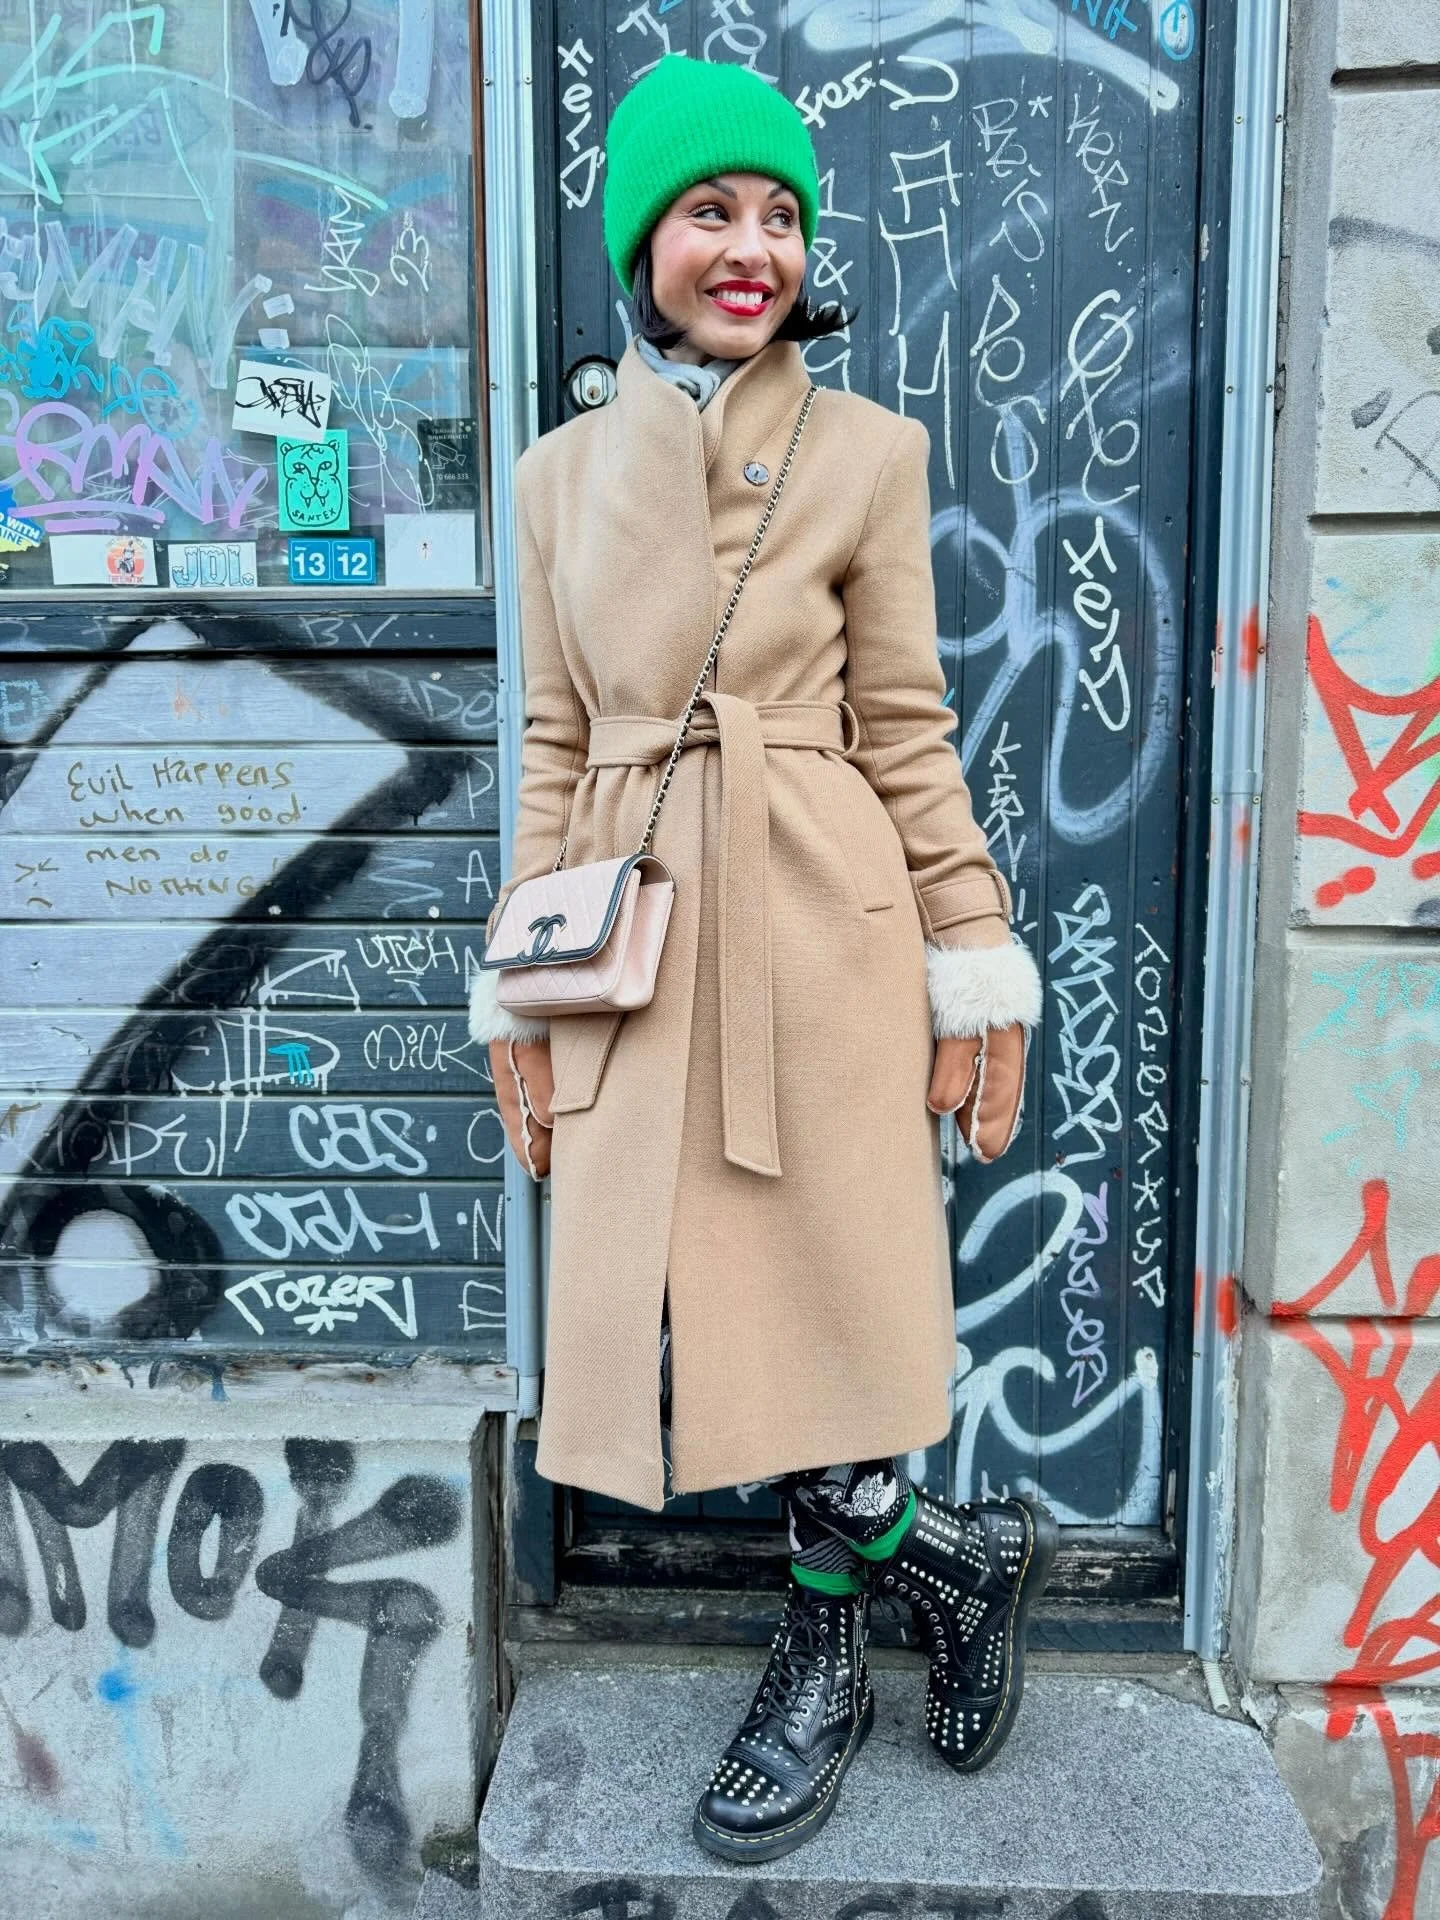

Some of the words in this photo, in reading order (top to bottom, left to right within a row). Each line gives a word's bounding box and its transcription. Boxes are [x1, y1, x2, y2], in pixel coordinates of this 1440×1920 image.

[0, 526, 23, 546] INE
[7, 515, 41, 541] WITH
[294, 552, 326, 577] 13
[337, 552, 368, 577] 12
[86, 846, 161, 864] men
[190, 844, 230, 864] do
